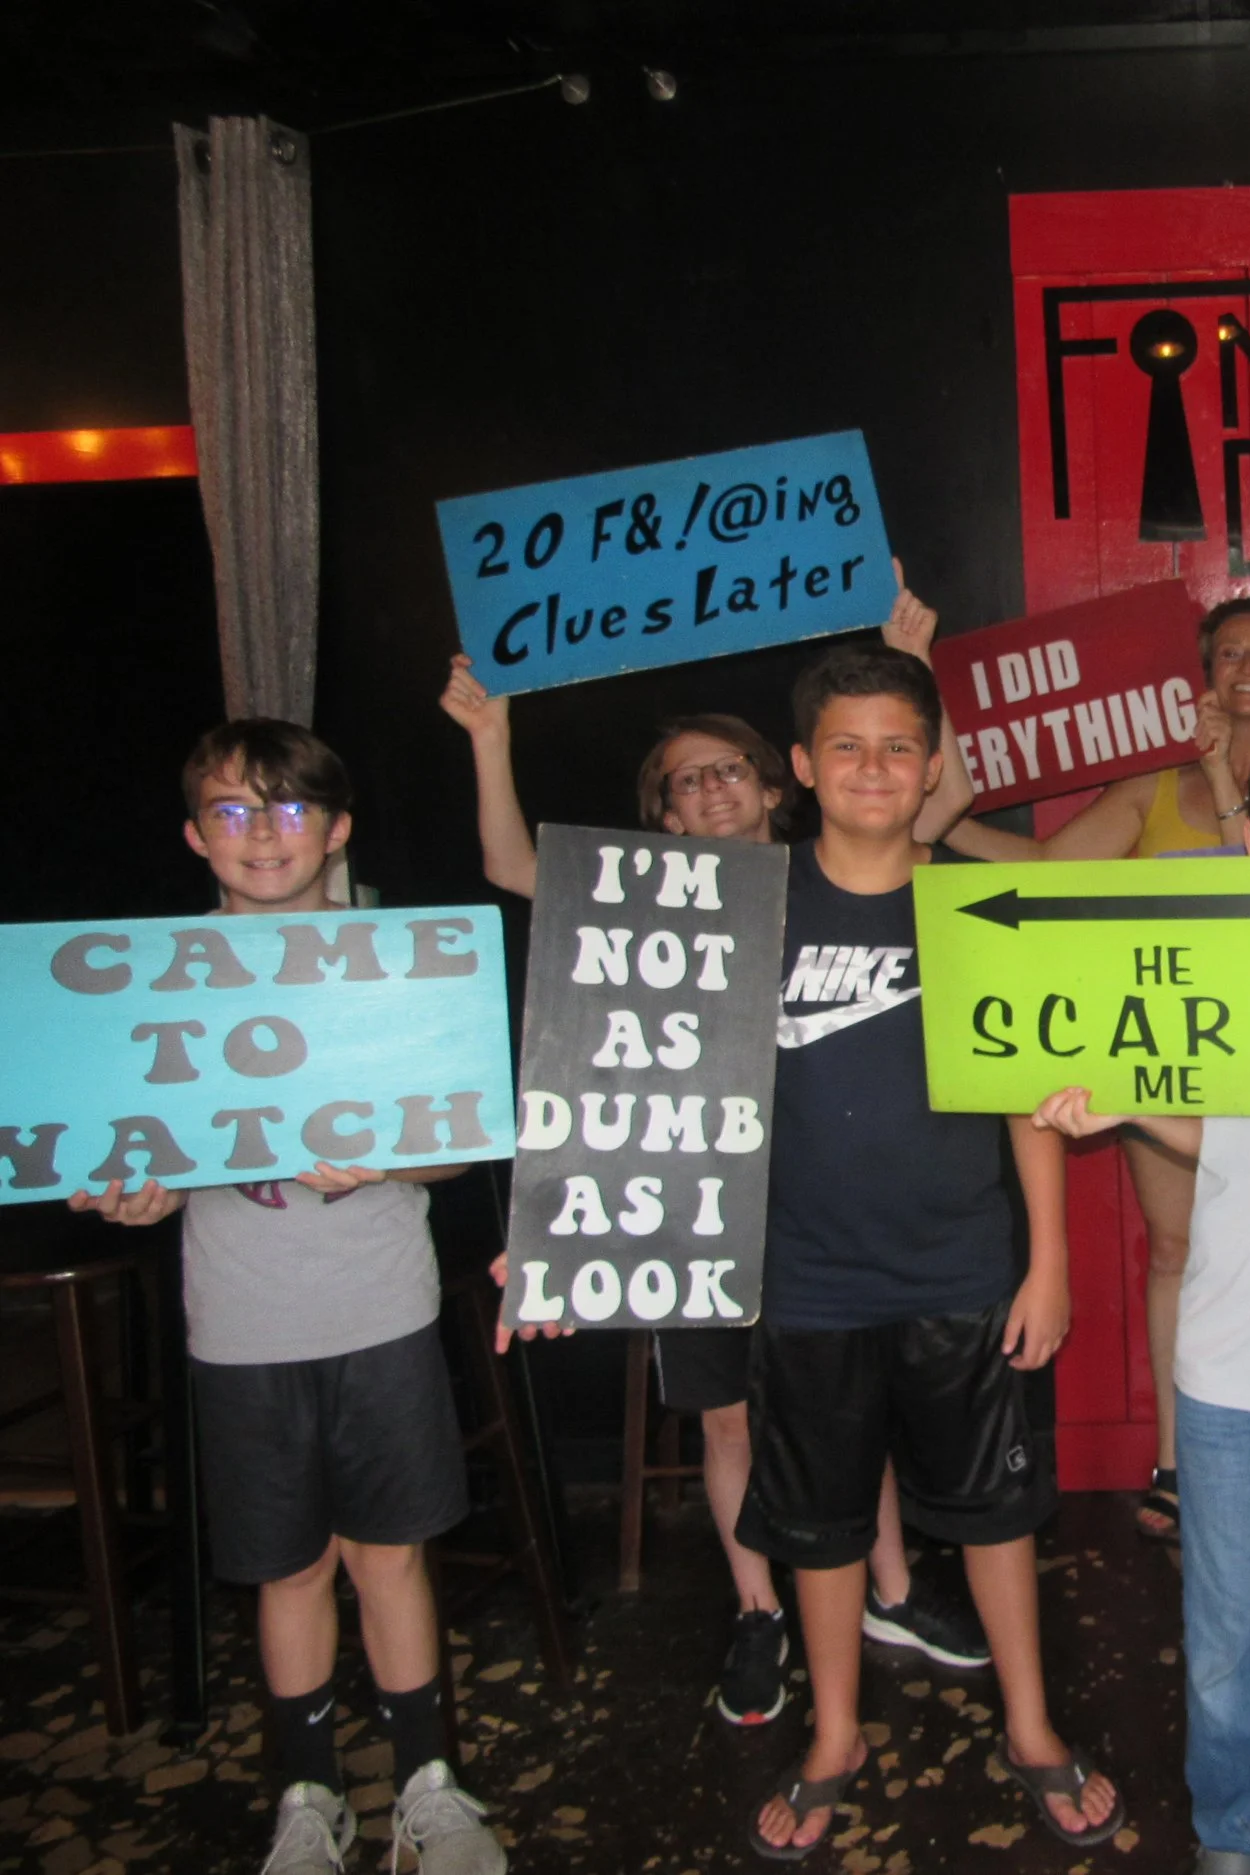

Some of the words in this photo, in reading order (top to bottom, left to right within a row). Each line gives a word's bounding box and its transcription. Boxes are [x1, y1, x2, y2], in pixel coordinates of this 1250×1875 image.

[473, 512, 564, 578] 20
[492, 593, 674, 666] Clues
[695, 555, 865, 627] Later
[971, 661, 992, 710] I
[997, 639, 1081, 703] DID
[957, 676, 1198, 794] ERYTHING
[592, 846, 723, 910] I'M
[51, 917, 479, 995] CAME
[571, 926, 735, 991] NOT
[784, 945, 914, 1001] NIKE
[1134, 945, 1194, 986] HE
[131, 1015, 308, 1084] TO
[592, 1010, 701, 1069] AS
[1134, 1065, 1205, 1105] ME
[517, 1090, 764, 1154] DUMB
[549, 1175, 664, 1235] AS
[692, 1177, 724, 1235] I
[518, 1259, 743, 1321] LOOK
